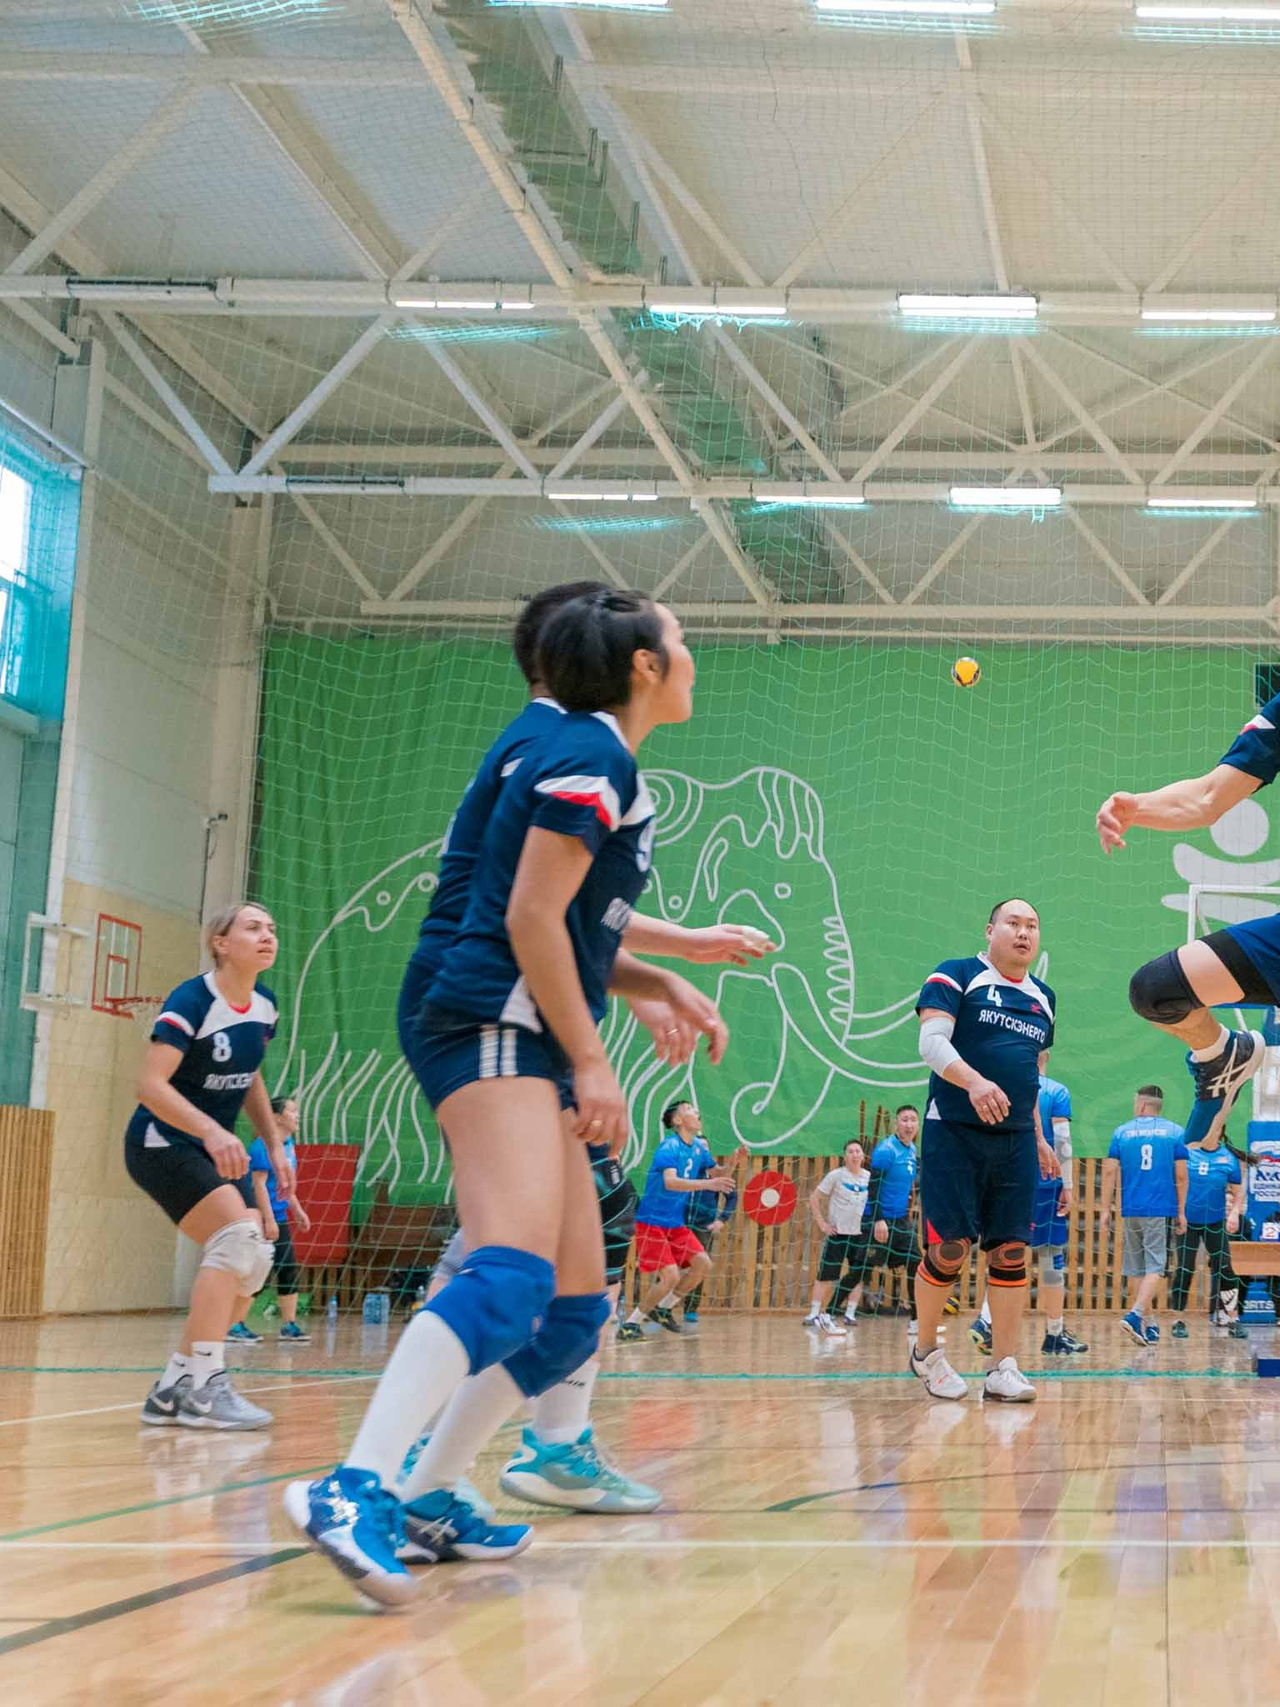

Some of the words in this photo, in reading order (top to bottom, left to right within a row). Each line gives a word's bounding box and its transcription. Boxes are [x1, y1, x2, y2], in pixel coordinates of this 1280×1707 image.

[987, 985, 1002, 1007] 4
[978, 1009, 1046, 1043] ЯКУТСКЭНЕРГО
[212, 1031, 232, 1062] 8
[684, 1158, 693, 1178] 2
[1140, 1144, 1153, 1170] 8
